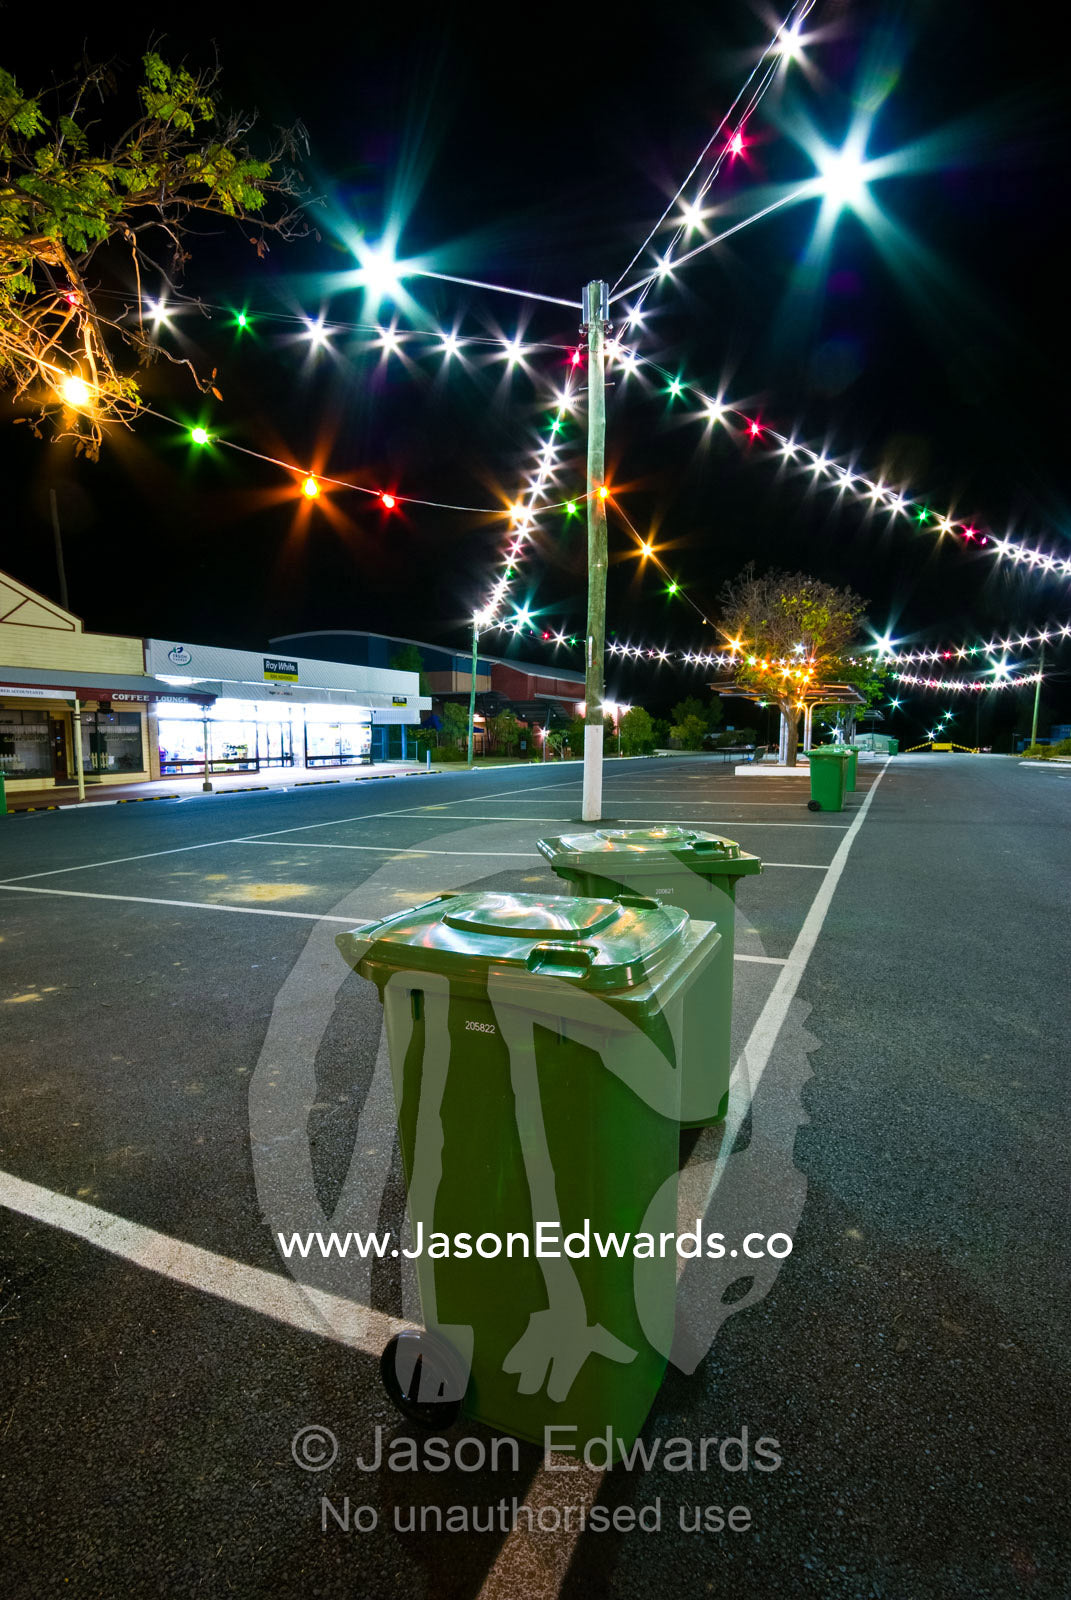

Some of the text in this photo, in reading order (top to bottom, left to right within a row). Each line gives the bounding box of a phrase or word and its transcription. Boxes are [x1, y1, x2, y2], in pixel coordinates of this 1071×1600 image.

[265, 660, 278, 671] Ray
[111, 693, 189, 703] COFFEE LOUNGE
[465, 1020, 496, 1034] 205822
